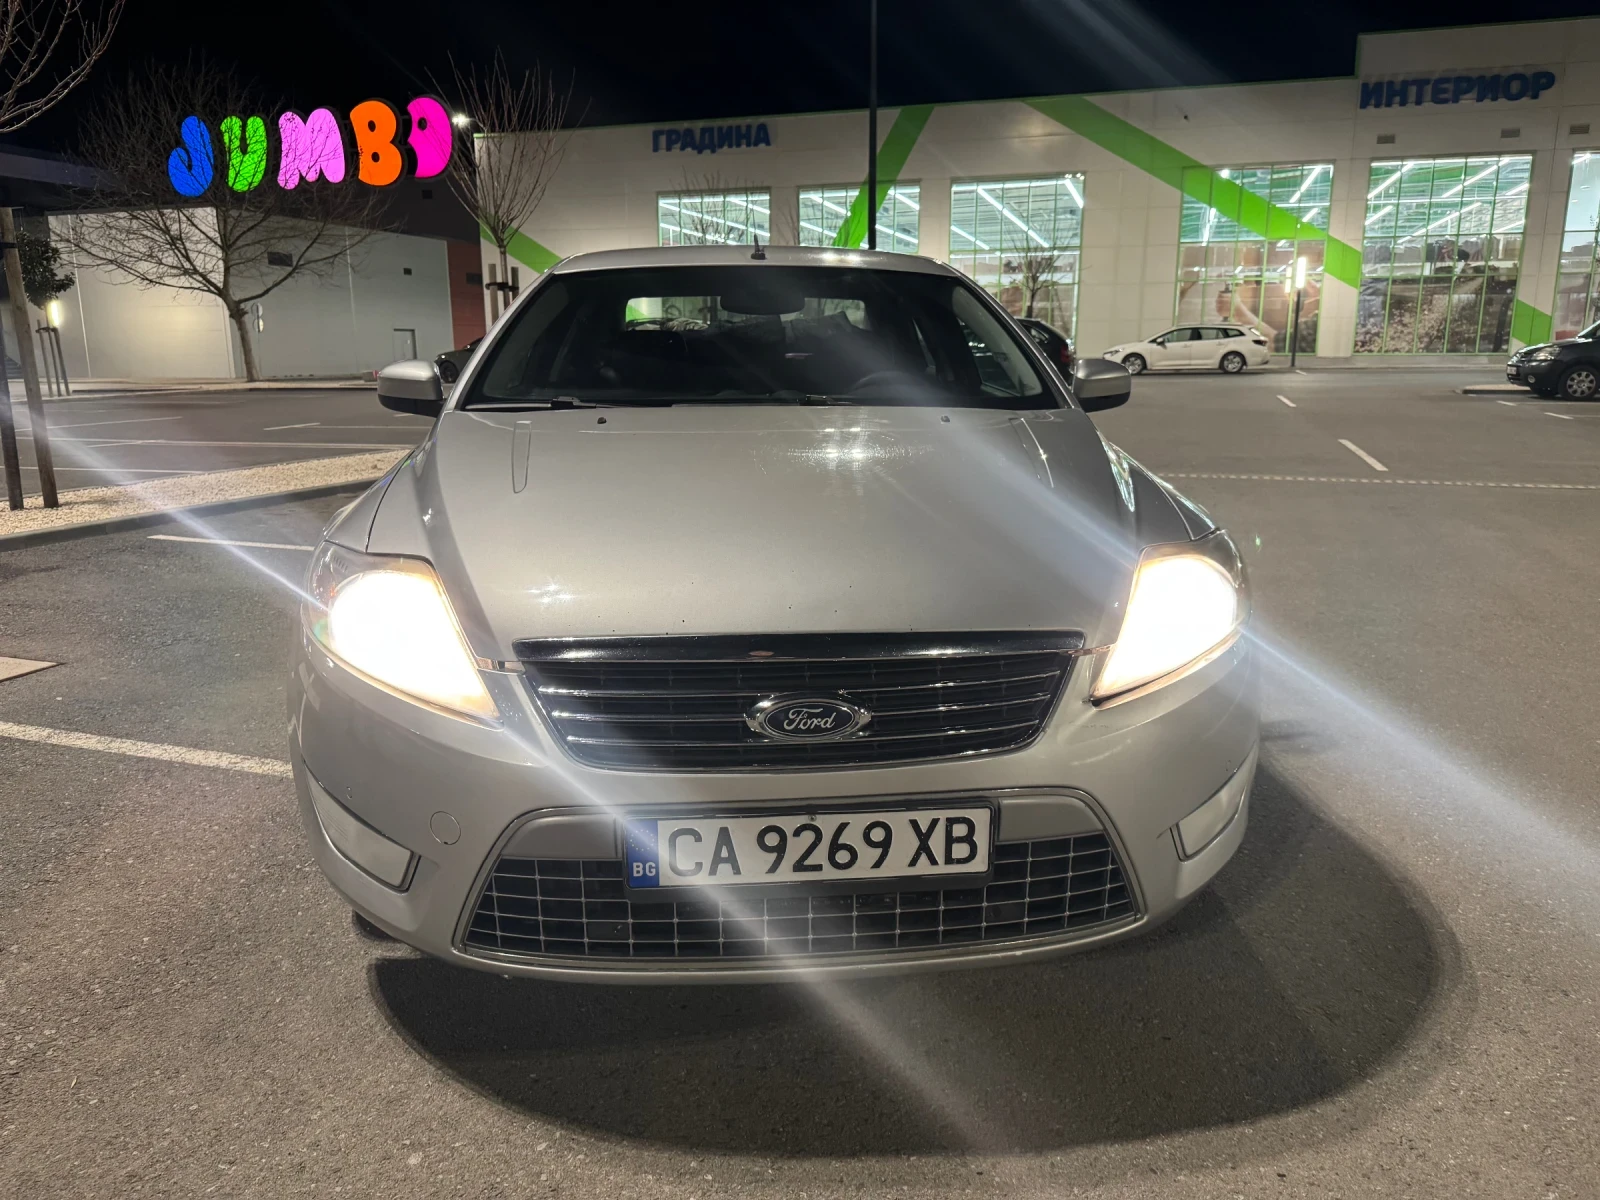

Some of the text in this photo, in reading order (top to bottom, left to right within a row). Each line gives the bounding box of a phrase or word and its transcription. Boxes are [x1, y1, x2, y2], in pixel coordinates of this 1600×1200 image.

[1359, 71, 1556, 109] ИНТЕРИОР
[168, 97, 452, 197] JUMBO
[652, 123, 771, 154] ГРАДИНА
[783, 708, 837, 730] Ford
[668, 816, 979, 877] CA 9269 XB
[632, 861, 657, 877] BG
